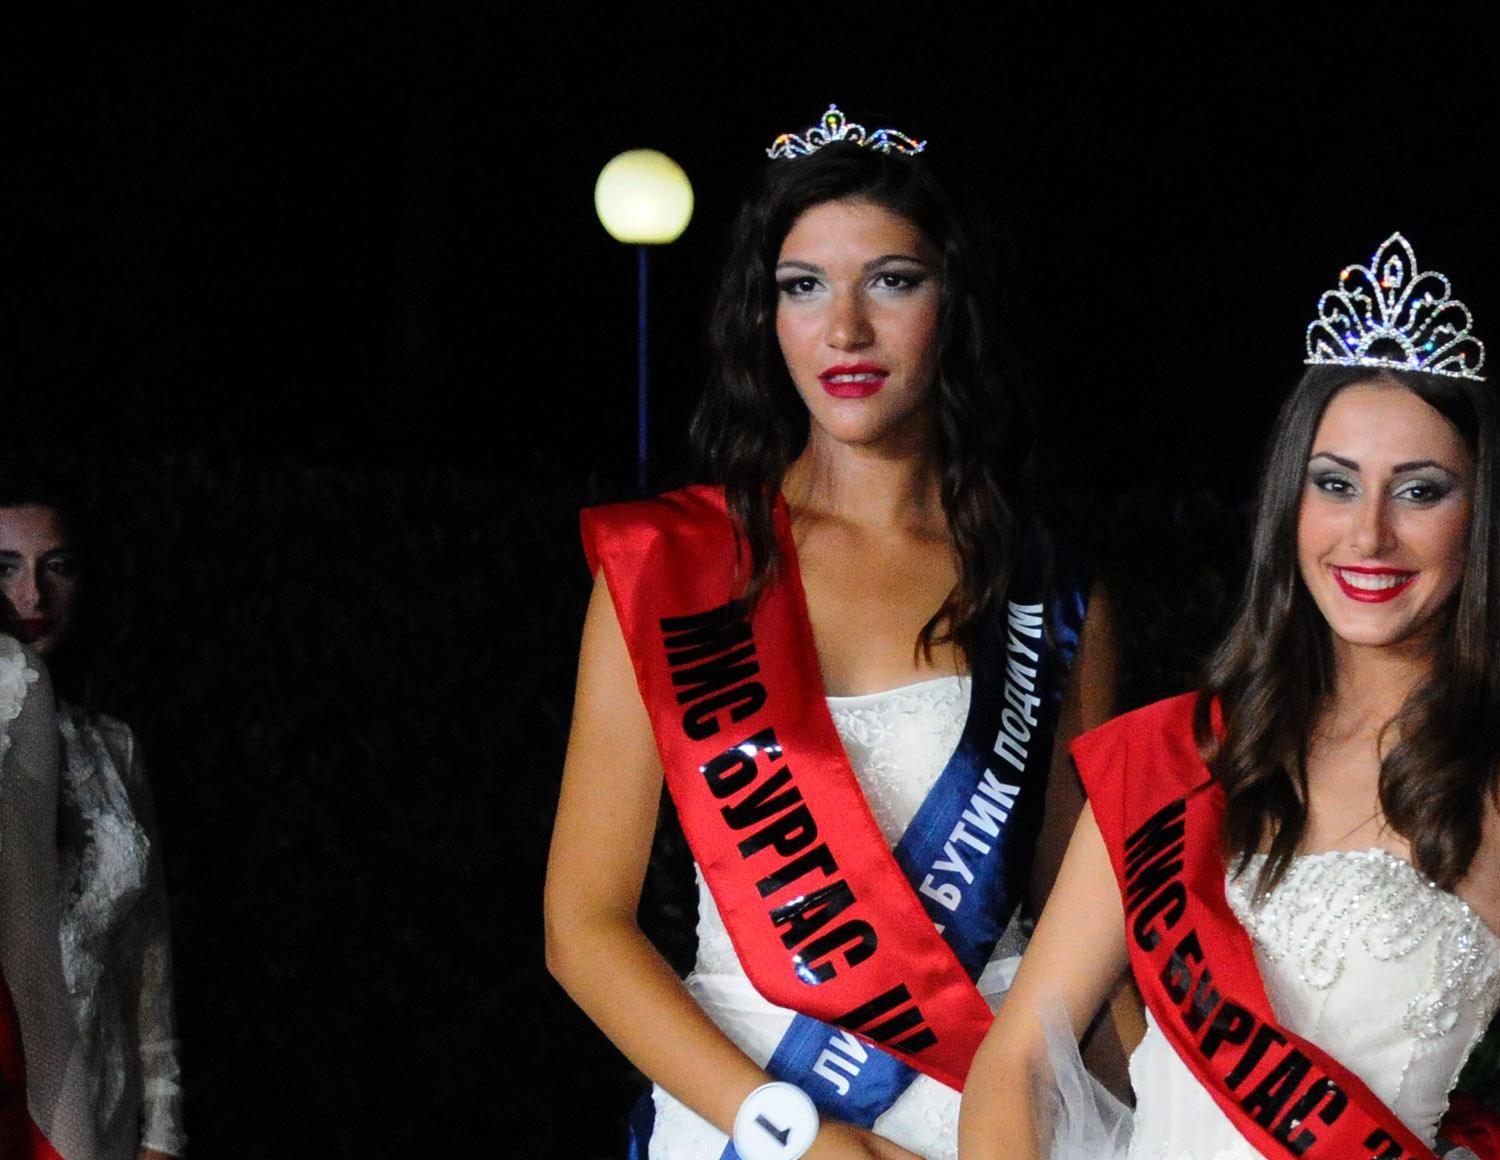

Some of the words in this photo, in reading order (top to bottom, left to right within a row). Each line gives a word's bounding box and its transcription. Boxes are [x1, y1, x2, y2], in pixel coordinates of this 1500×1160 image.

[660, 600, 767, 741] МИС
[919, 768, 1021, 912] БУТИК
[993, 601, 1044, 773] ПОДИУМ
[701, 726, 878, 986] БУРГАС
[1124, 799, 1187, 953] МИС
[754, 1113, 793, 1147] 1
